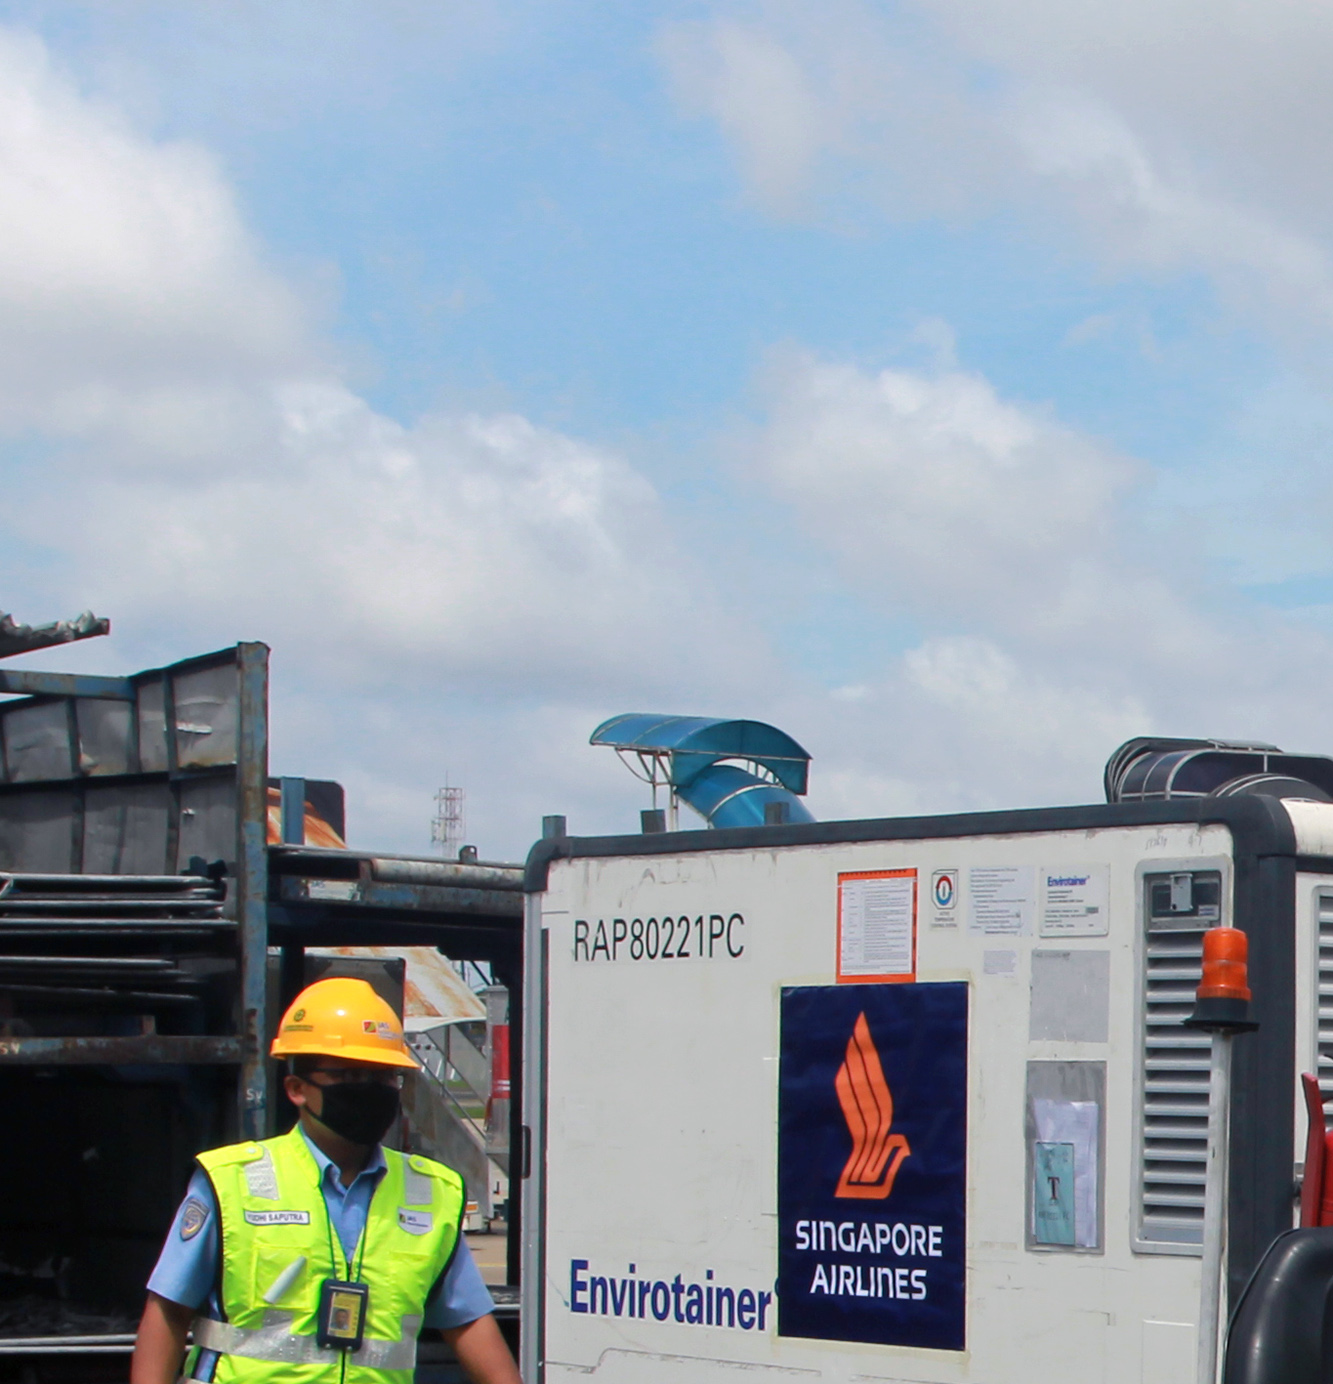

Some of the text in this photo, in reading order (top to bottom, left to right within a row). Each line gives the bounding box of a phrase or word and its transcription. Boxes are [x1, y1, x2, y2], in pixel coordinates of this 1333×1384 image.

[573, 912, 745, 962] RAP80221PC
[795, 1220, 943, 1257] SINGAPORE
[570, 1259, 772, 1332] Envirotainer
[810, 1267, 927, 1301] AIRLINES
